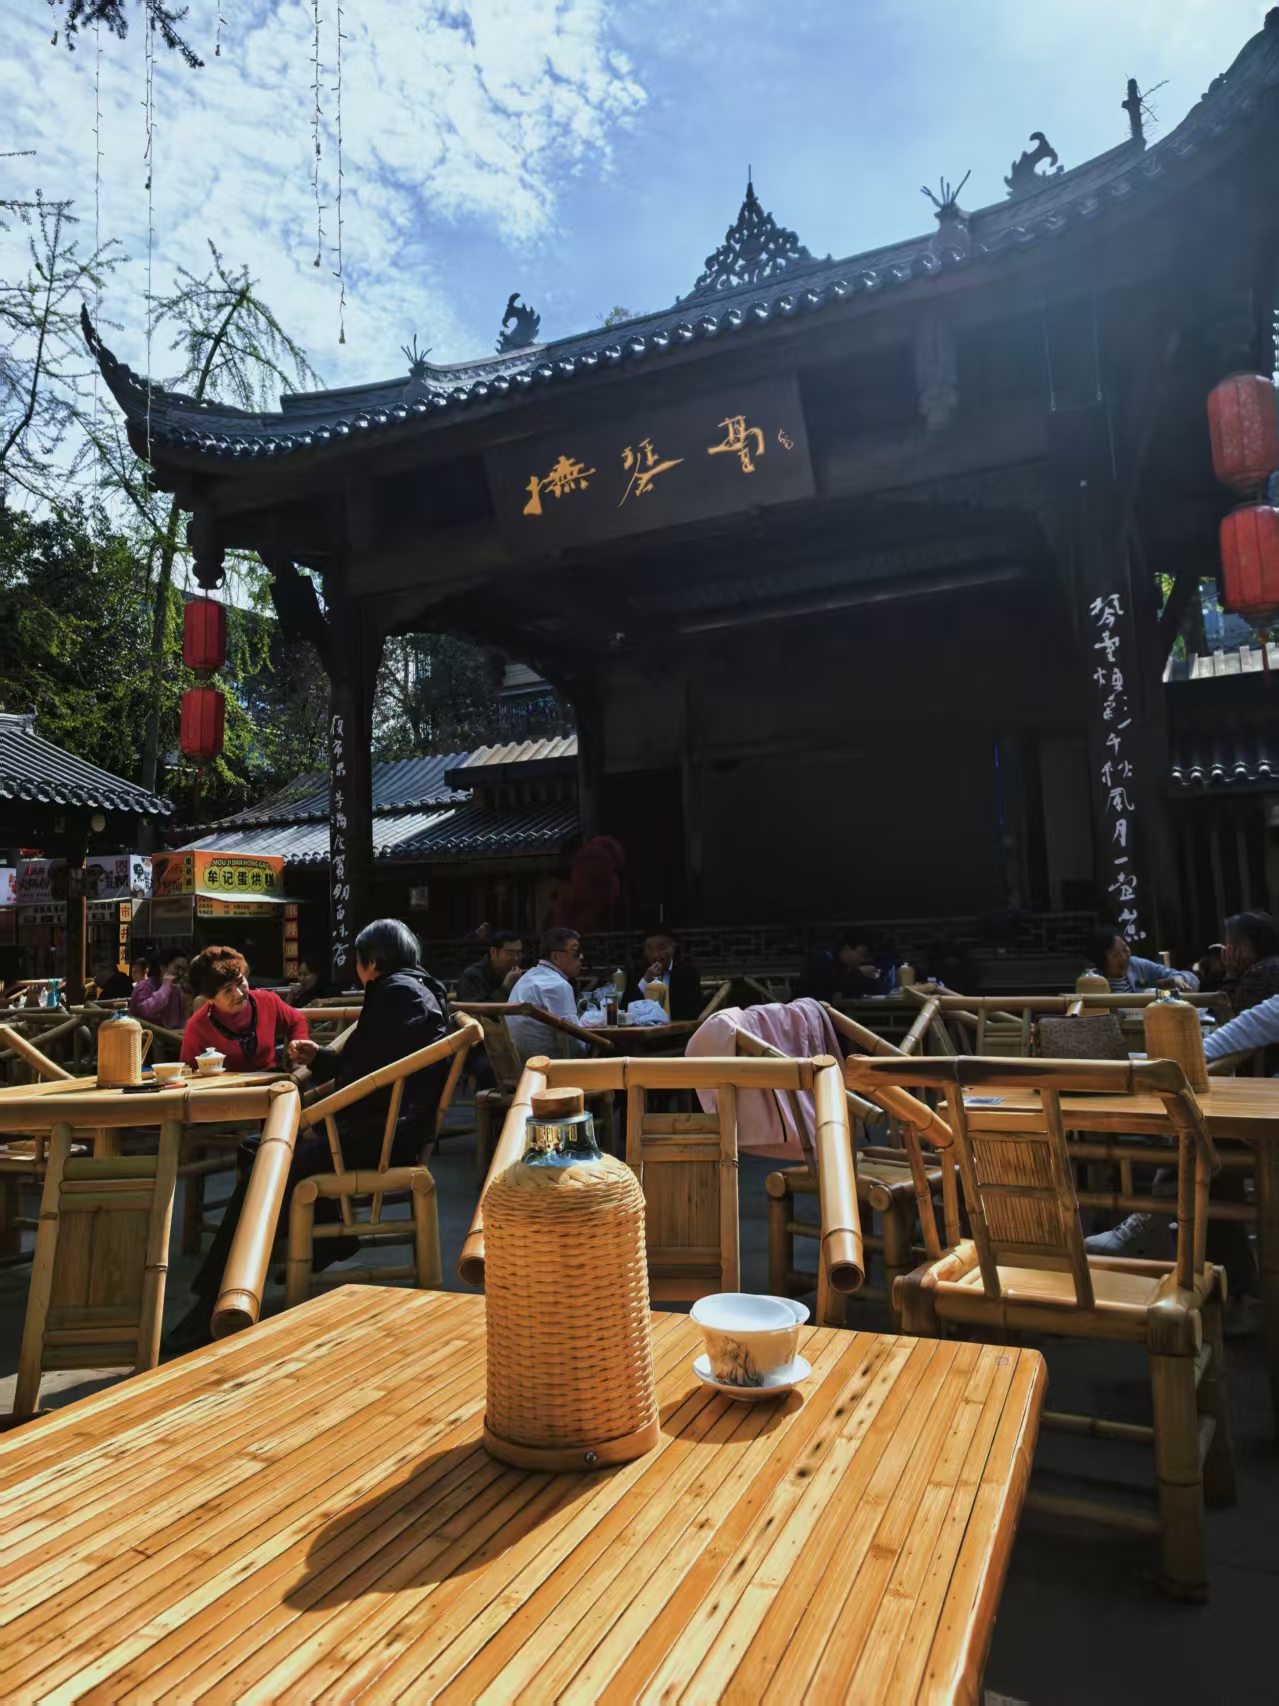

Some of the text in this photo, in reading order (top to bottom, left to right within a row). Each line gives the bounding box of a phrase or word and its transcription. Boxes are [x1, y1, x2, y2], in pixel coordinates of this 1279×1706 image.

[208, 870, 274, 887] 牟记蛋烘糕
